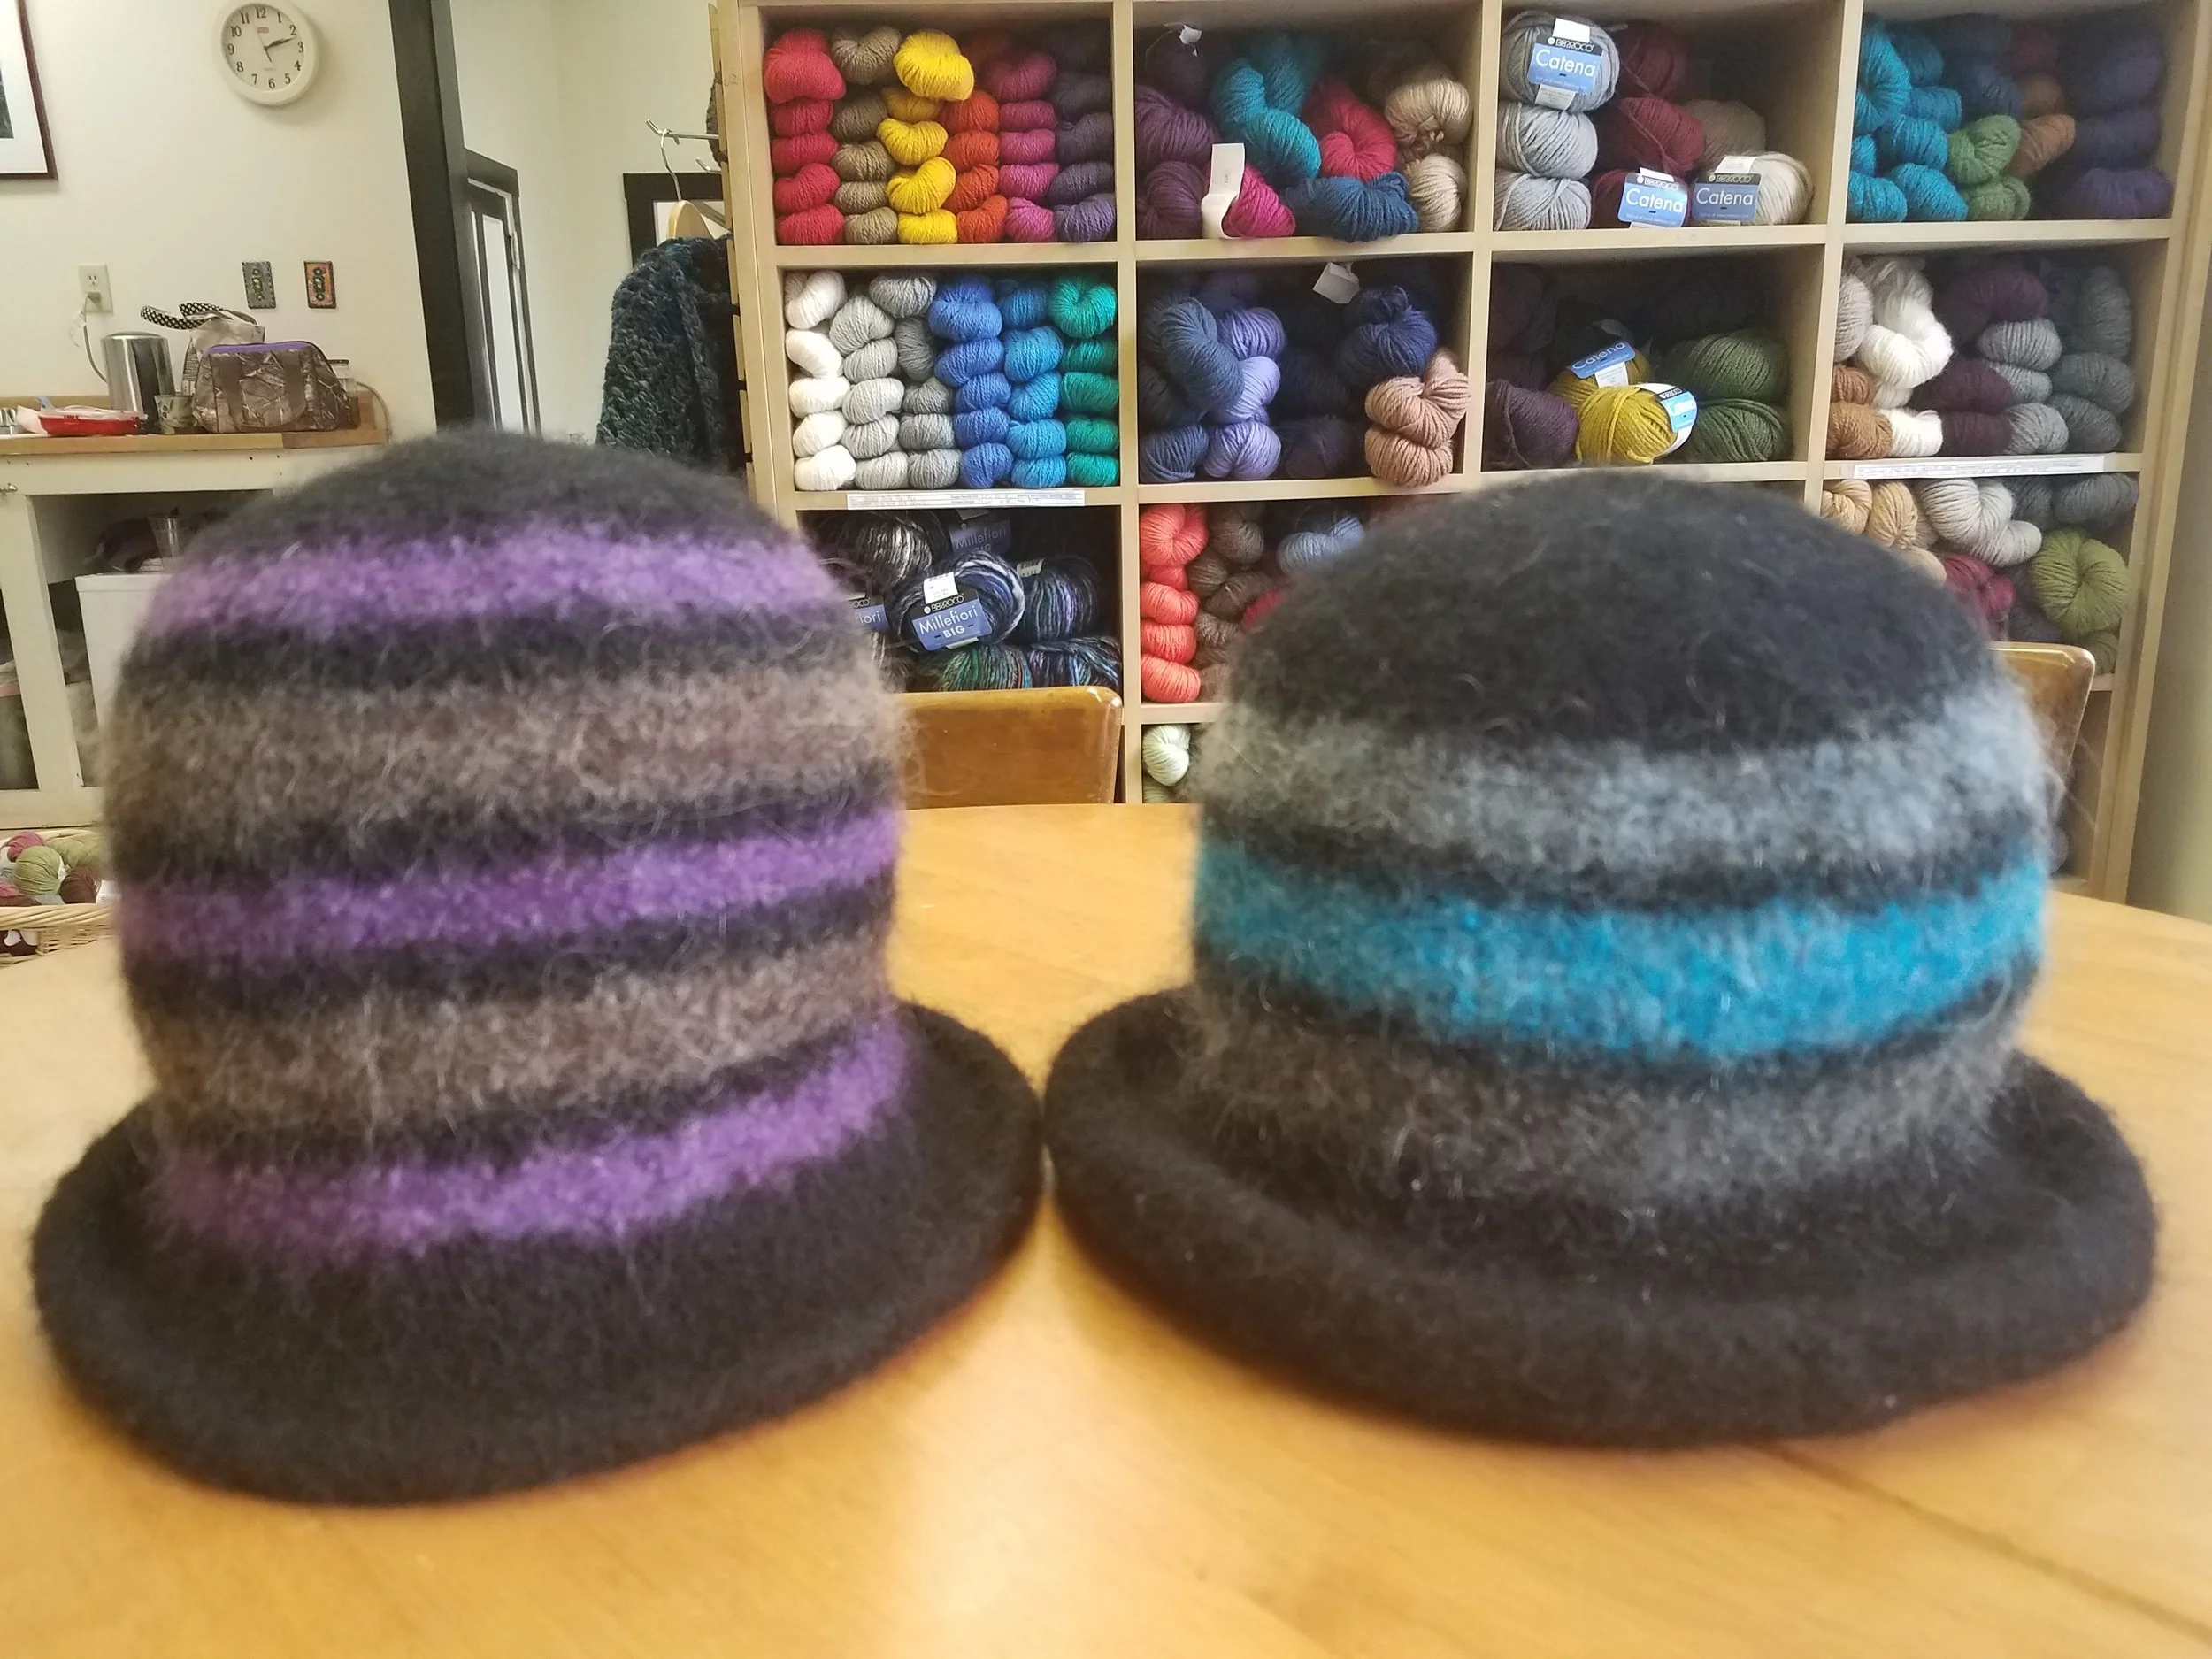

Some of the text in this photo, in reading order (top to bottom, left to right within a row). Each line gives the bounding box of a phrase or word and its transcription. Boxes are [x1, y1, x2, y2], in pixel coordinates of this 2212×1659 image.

[240, 12, 250, 24] 11
[255, 7, 266, 19] 12
[277, 12, 282, 23] 1
[230, 26, 242, 37] 10
[289, 25, 296, 36] 2
[227, 43, 234, 55] 9
[296, 42, 304, 53] 3
[236, 62, 243, 73] 8
[294, 59, 301, 72] 4
[1535, 49, 1596, 78] Catena
[251, 73, 257, 85] 7
[268, 78, 276, 89] 6
[284, 73, 291, 85] 5
[1625, 188, 1685, 213] Catena
[1695, 187, 1755, 206] Catena
[931, 595, 964, 612] BERROCO
[918, 604, 978, 635] Millefiori
[941, 624, 965, 638] BIG
